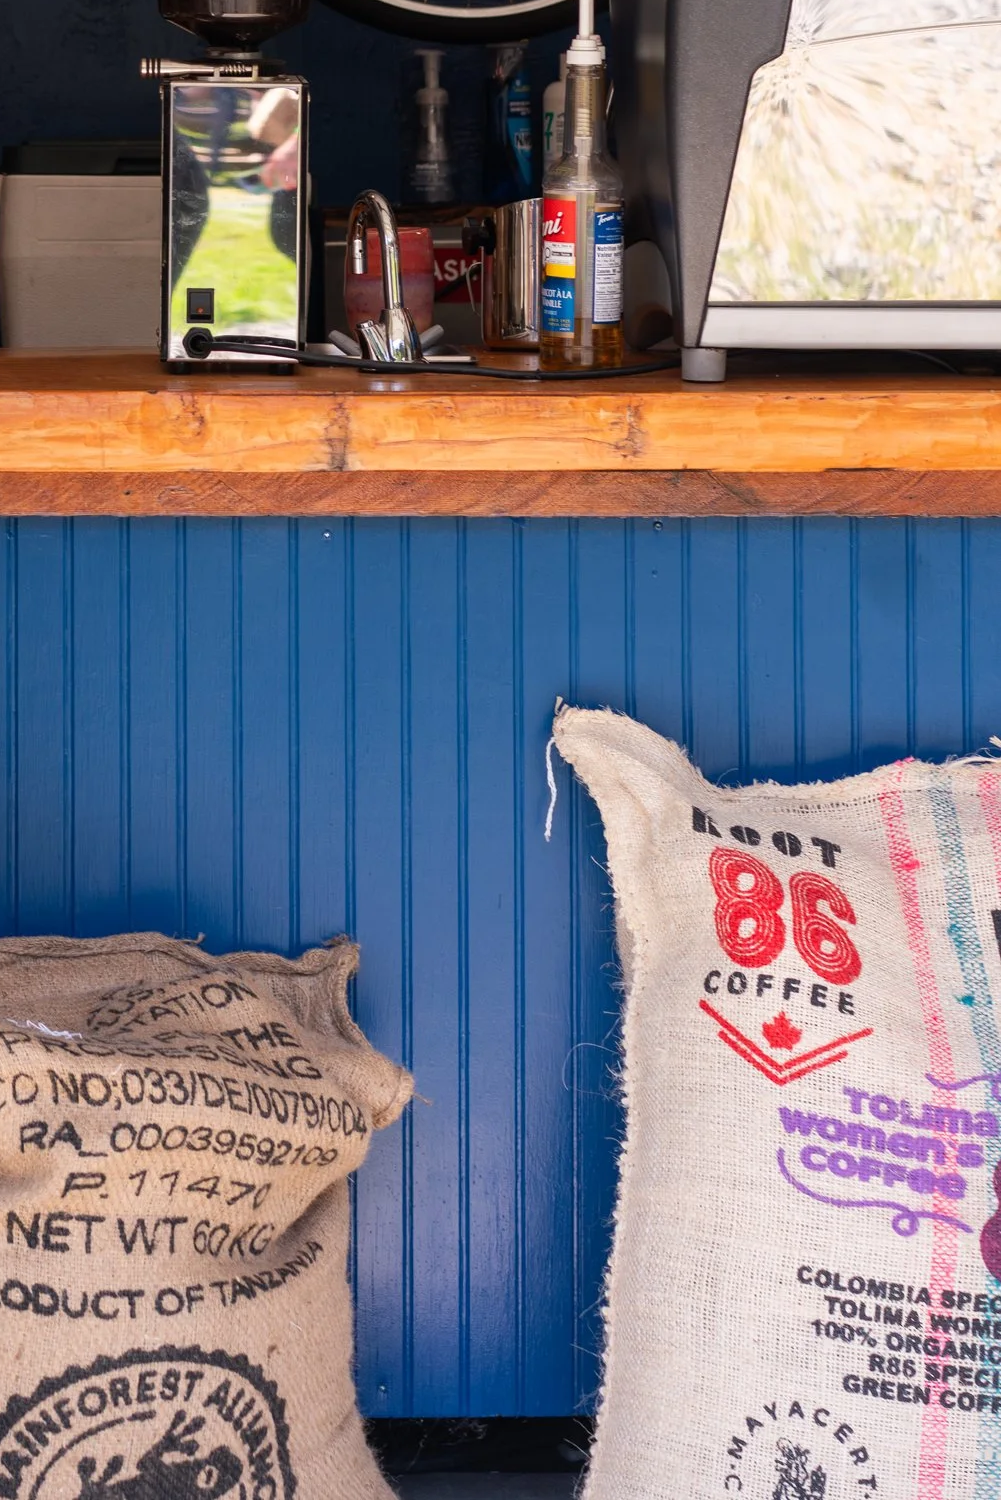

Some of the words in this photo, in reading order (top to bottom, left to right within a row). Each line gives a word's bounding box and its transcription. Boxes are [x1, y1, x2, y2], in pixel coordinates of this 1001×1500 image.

[709, 846, 862, 985] 86
[703, 970, 855, 1016] COFFEE
[6, 1210, 106, 1252] NET
[115, 1215, 189, 1255] WT
[153, 1284, 205, 1317] OF
[208, 1241, 324, 1308] TANZANIA
[797, 1265, 932, 1306] COLOMBIA
[824, 1294, 923, 1330] TOLIMA
[812, 1319, 878, 1348] 100%
[885, 1331, 1001, 1365] ORGANIC
[868, 1353, 917, 1378] R86
[842, 1373, 931, 1405] GREEN
